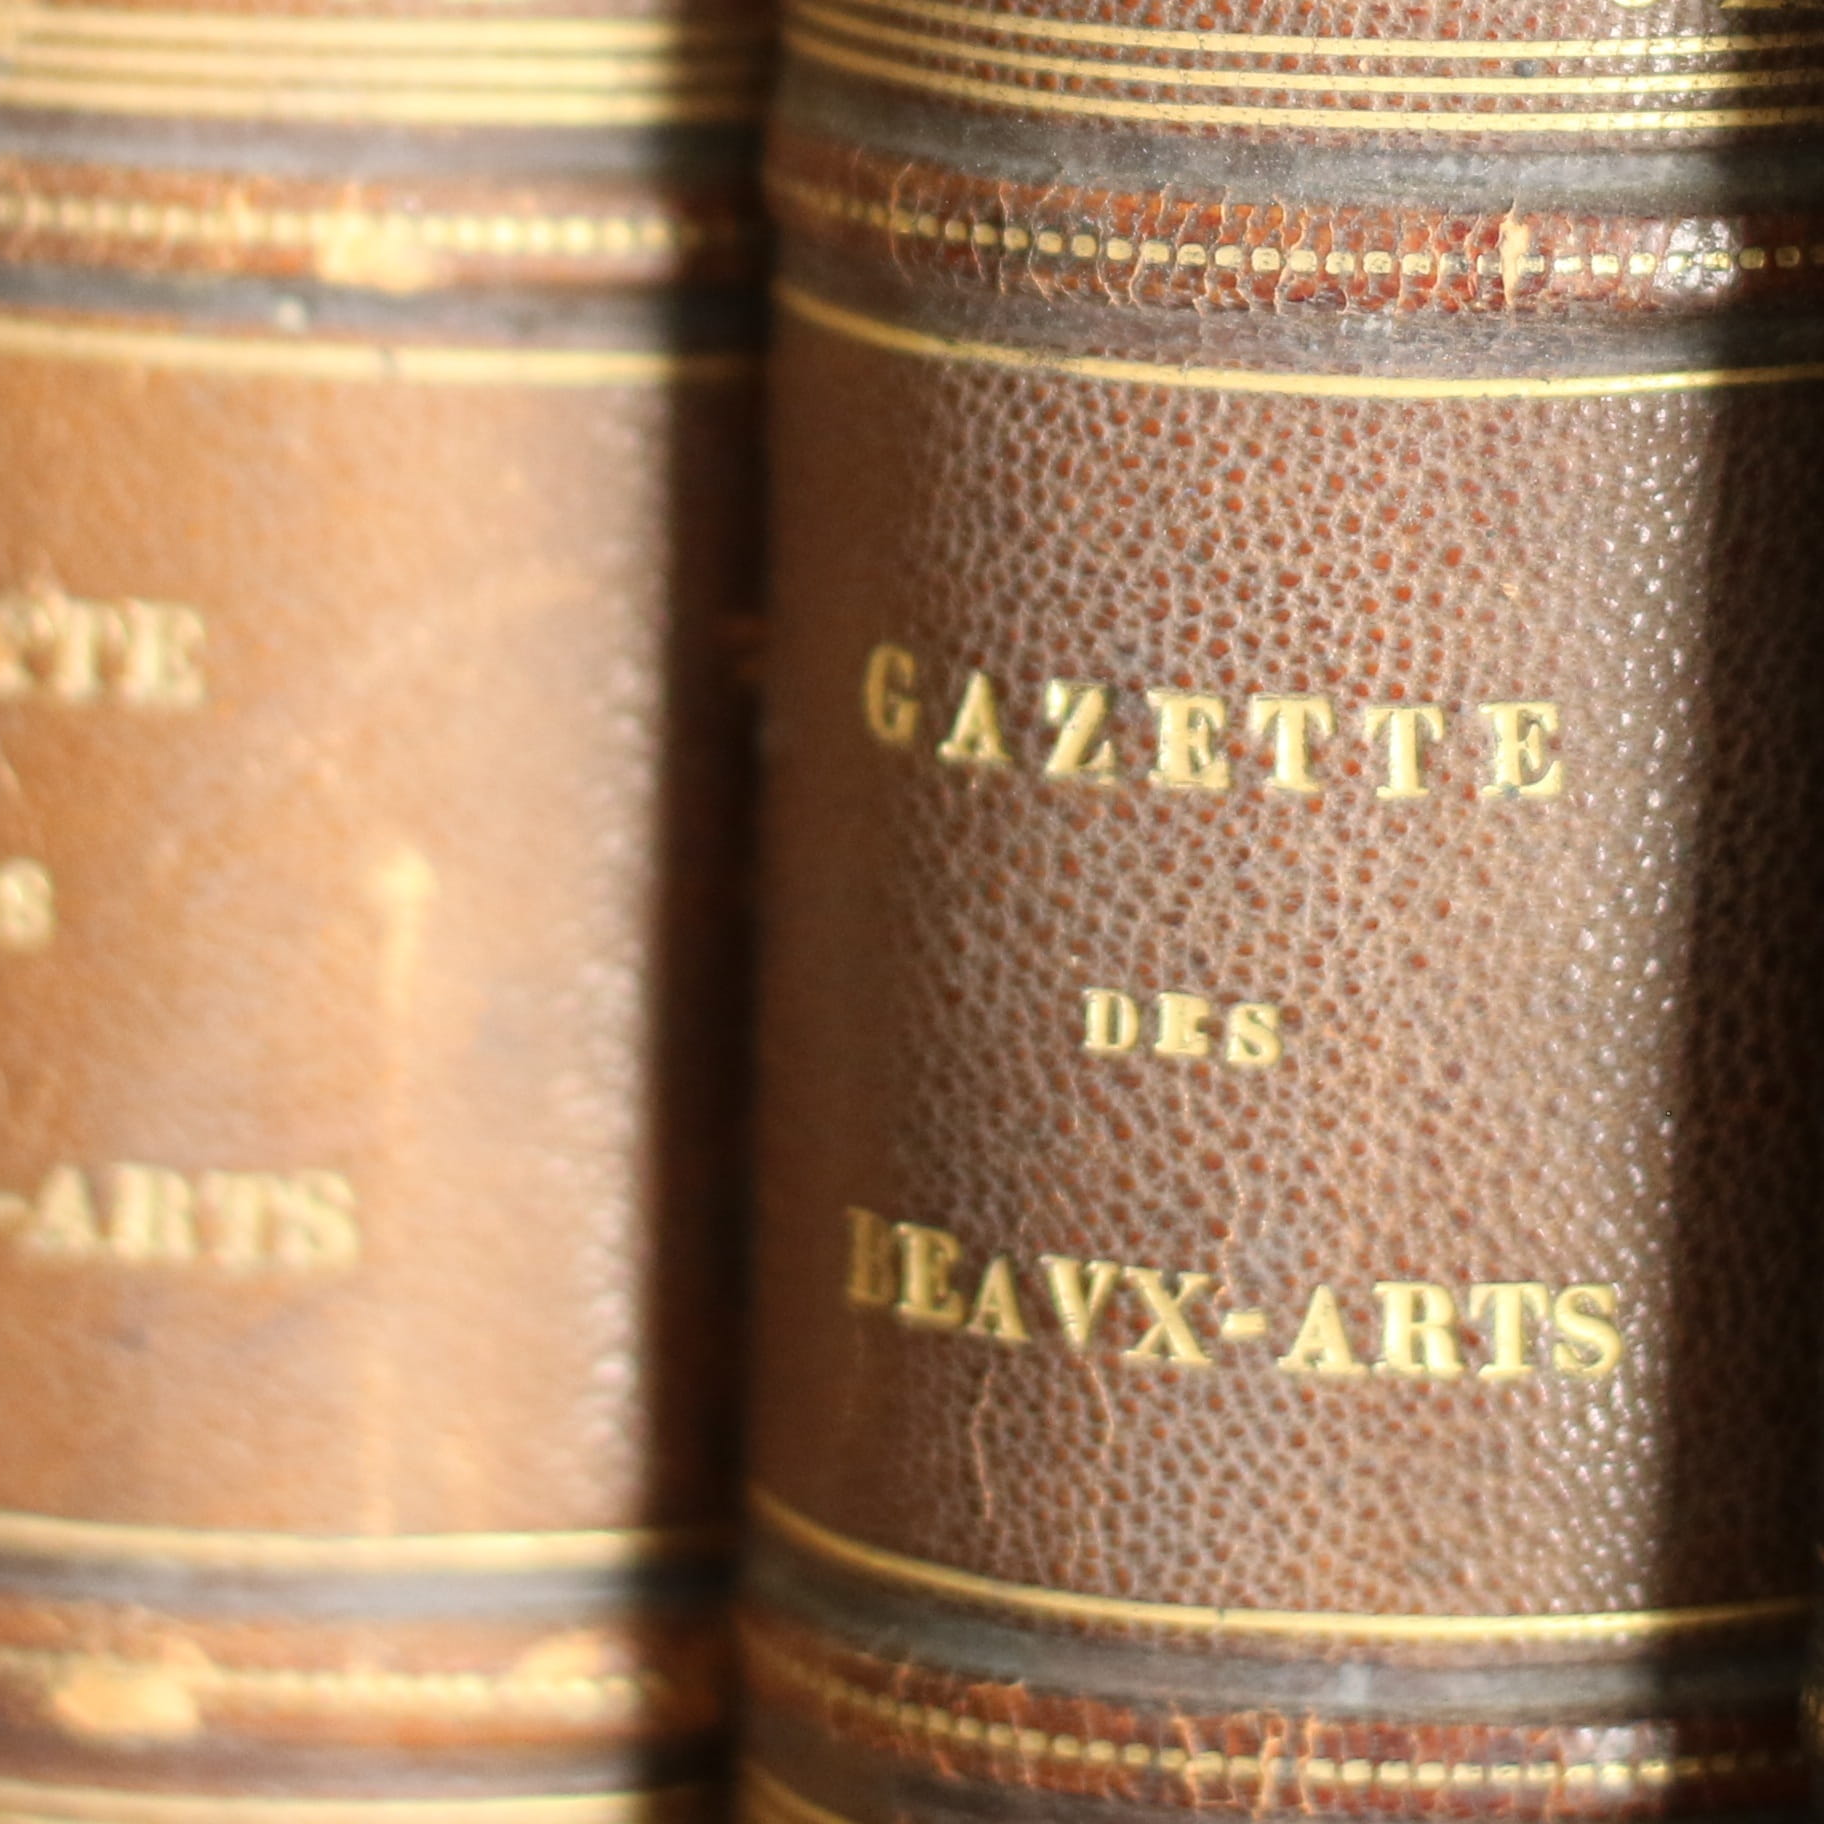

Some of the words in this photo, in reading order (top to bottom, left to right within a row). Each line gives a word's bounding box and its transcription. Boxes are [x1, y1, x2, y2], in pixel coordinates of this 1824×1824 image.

[864, 643, 1563, 798] GAZETTE
[1083, 988, 1282, 1066] DES
[844, 1206, 1622, 1378] BEAVX-ARTS
